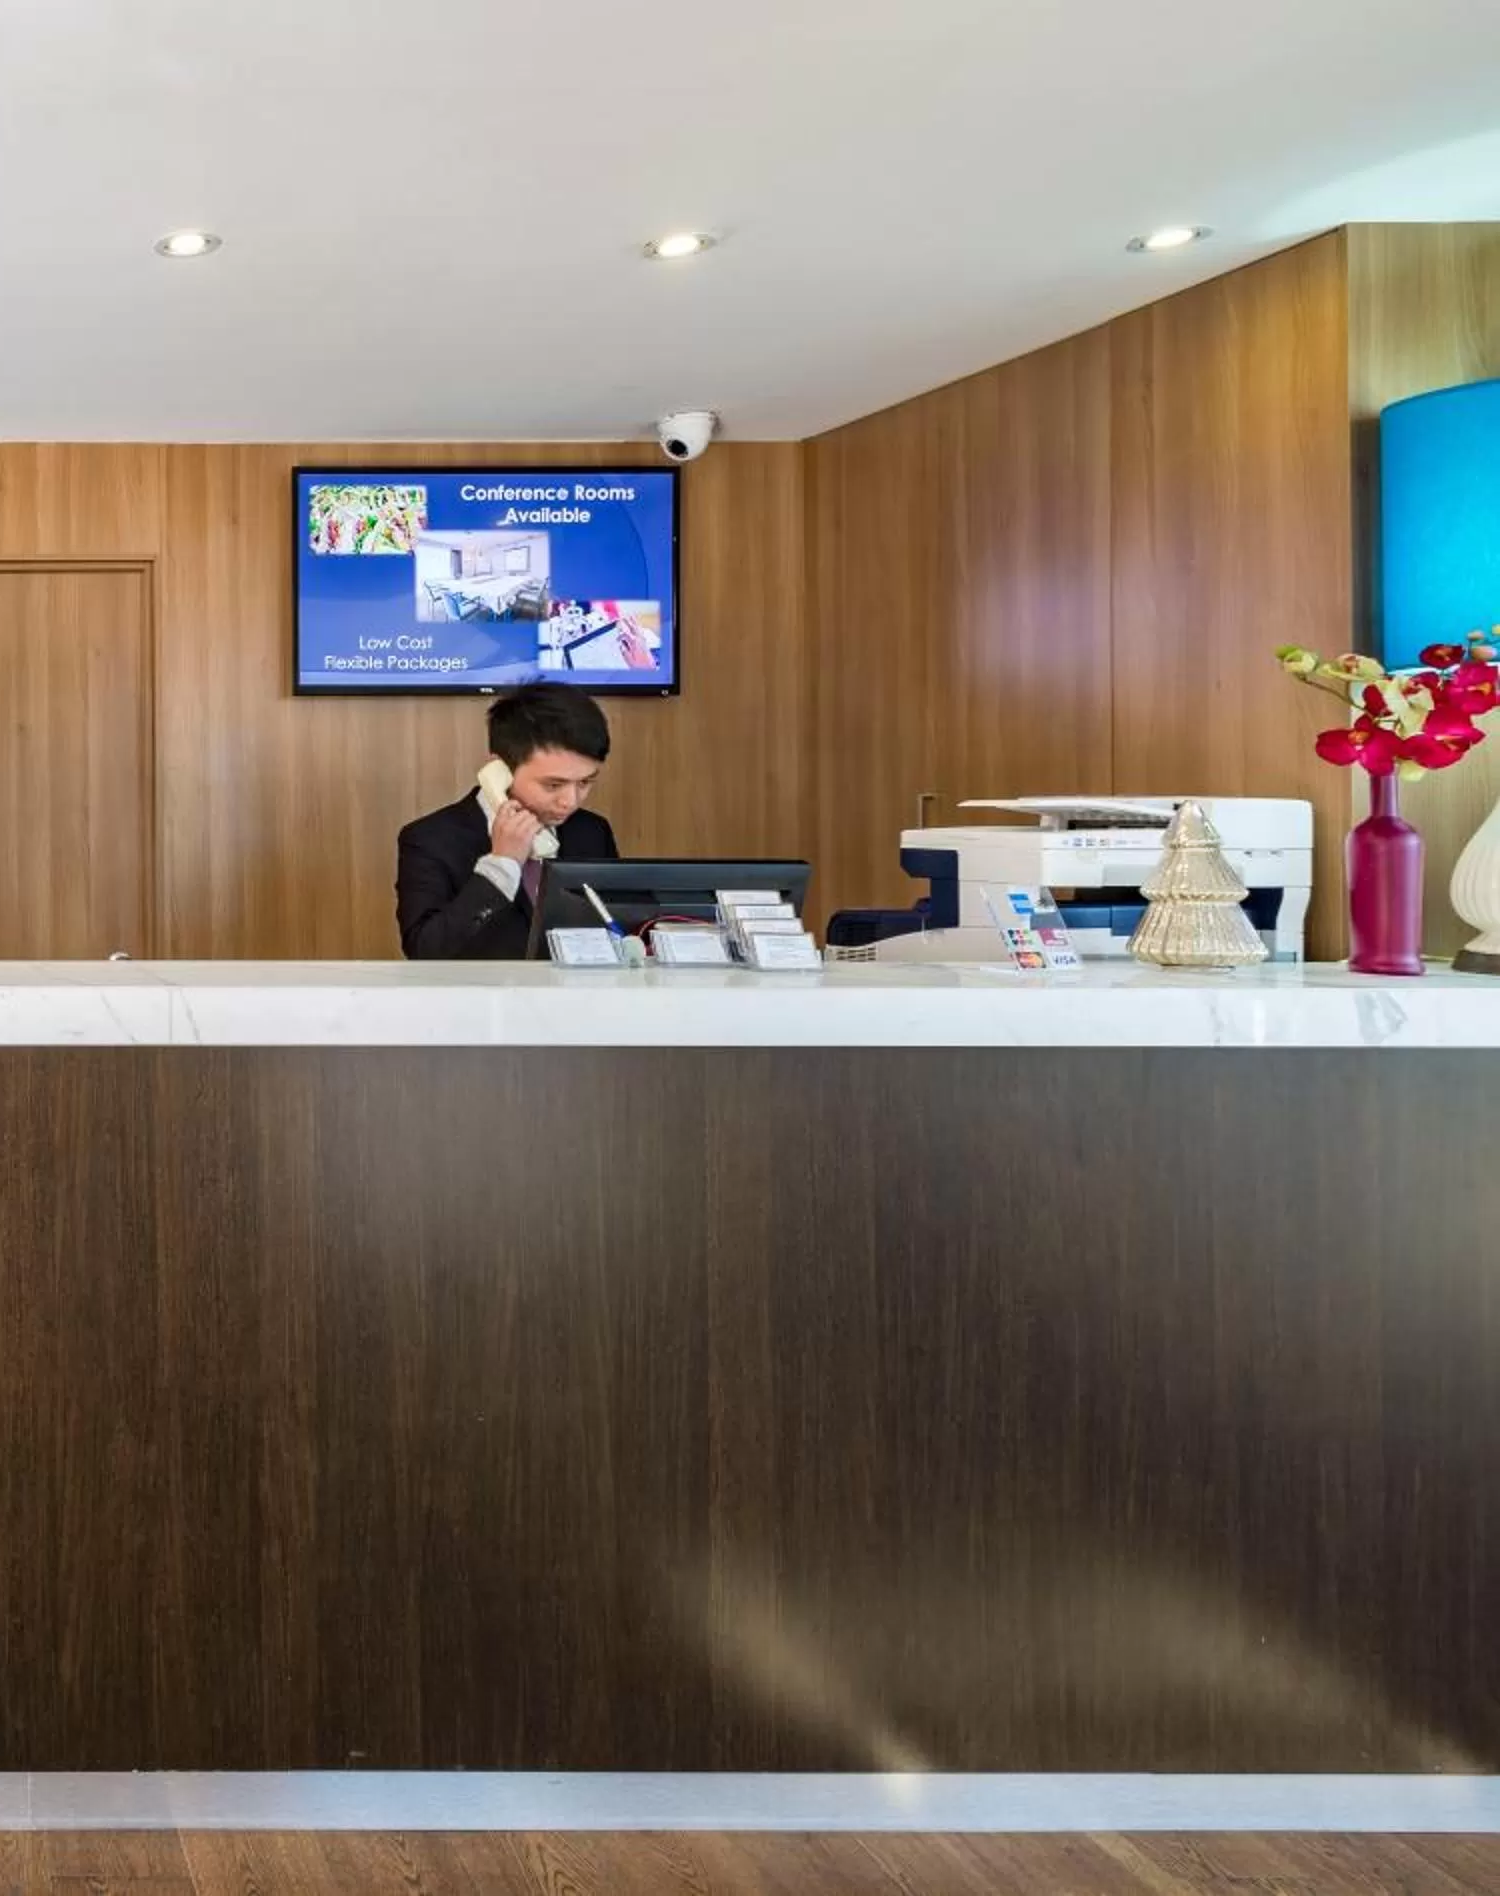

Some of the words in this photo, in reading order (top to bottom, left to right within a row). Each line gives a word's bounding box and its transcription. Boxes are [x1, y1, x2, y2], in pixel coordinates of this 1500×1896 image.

[460, 484, 569, 501] Conference
[574, 484, 635, 501] Rooms
[504, 507, 591, 523] Available
[359, 635, 392, 650] Low
[396, 635, 433, 650] Cost
[324, 655, 383, 670] Flexible
[387, 655, 468, 673] Packages
